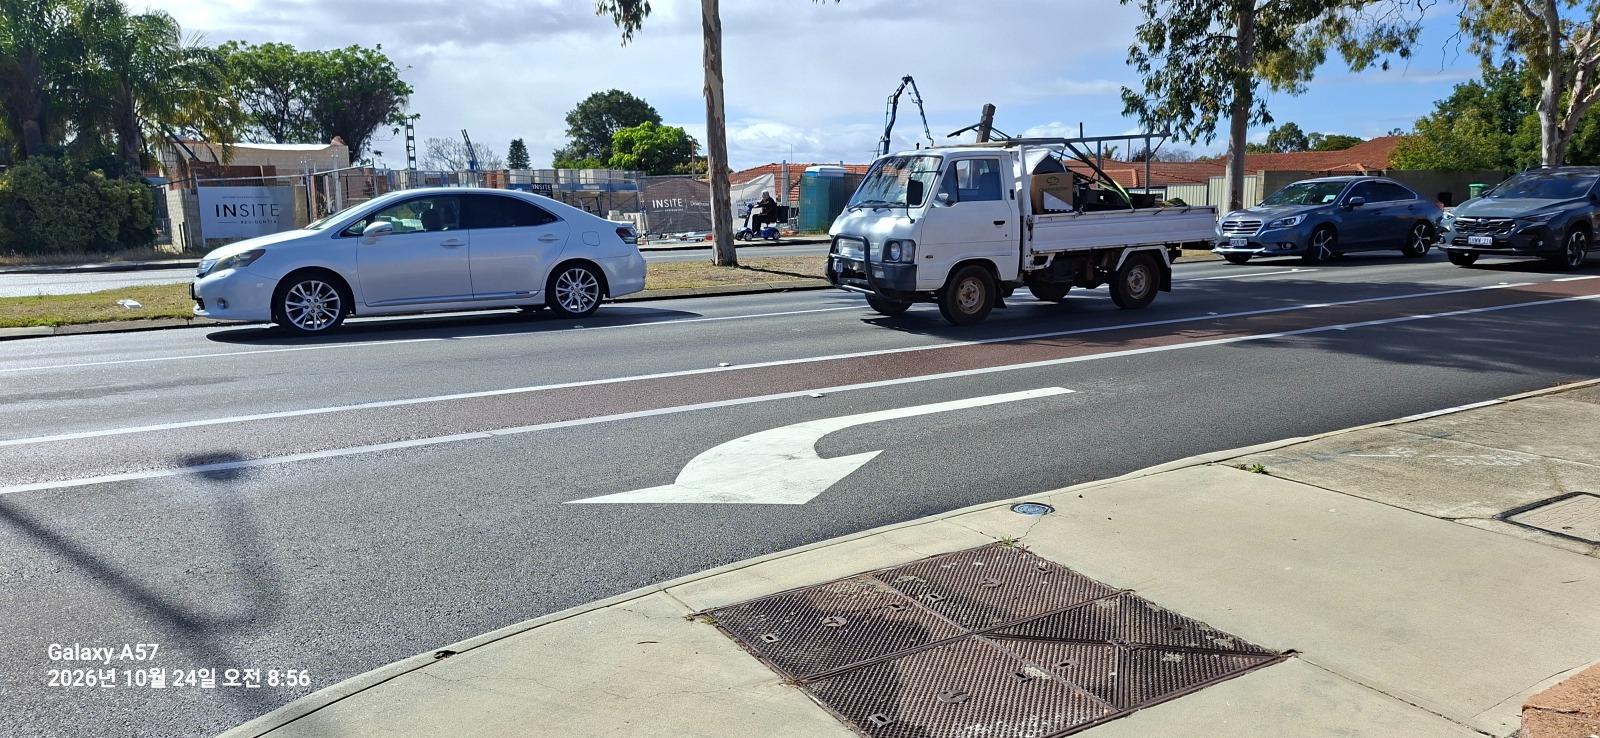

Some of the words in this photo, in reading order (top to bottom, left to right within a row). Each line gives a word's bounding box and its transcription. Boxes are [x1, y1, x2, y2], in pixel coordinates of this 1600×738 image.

[531, 183, 552, 191] INSITE
[652, 198, 683, 208] INSITE
[215, 203, 280, 218] INSITE
